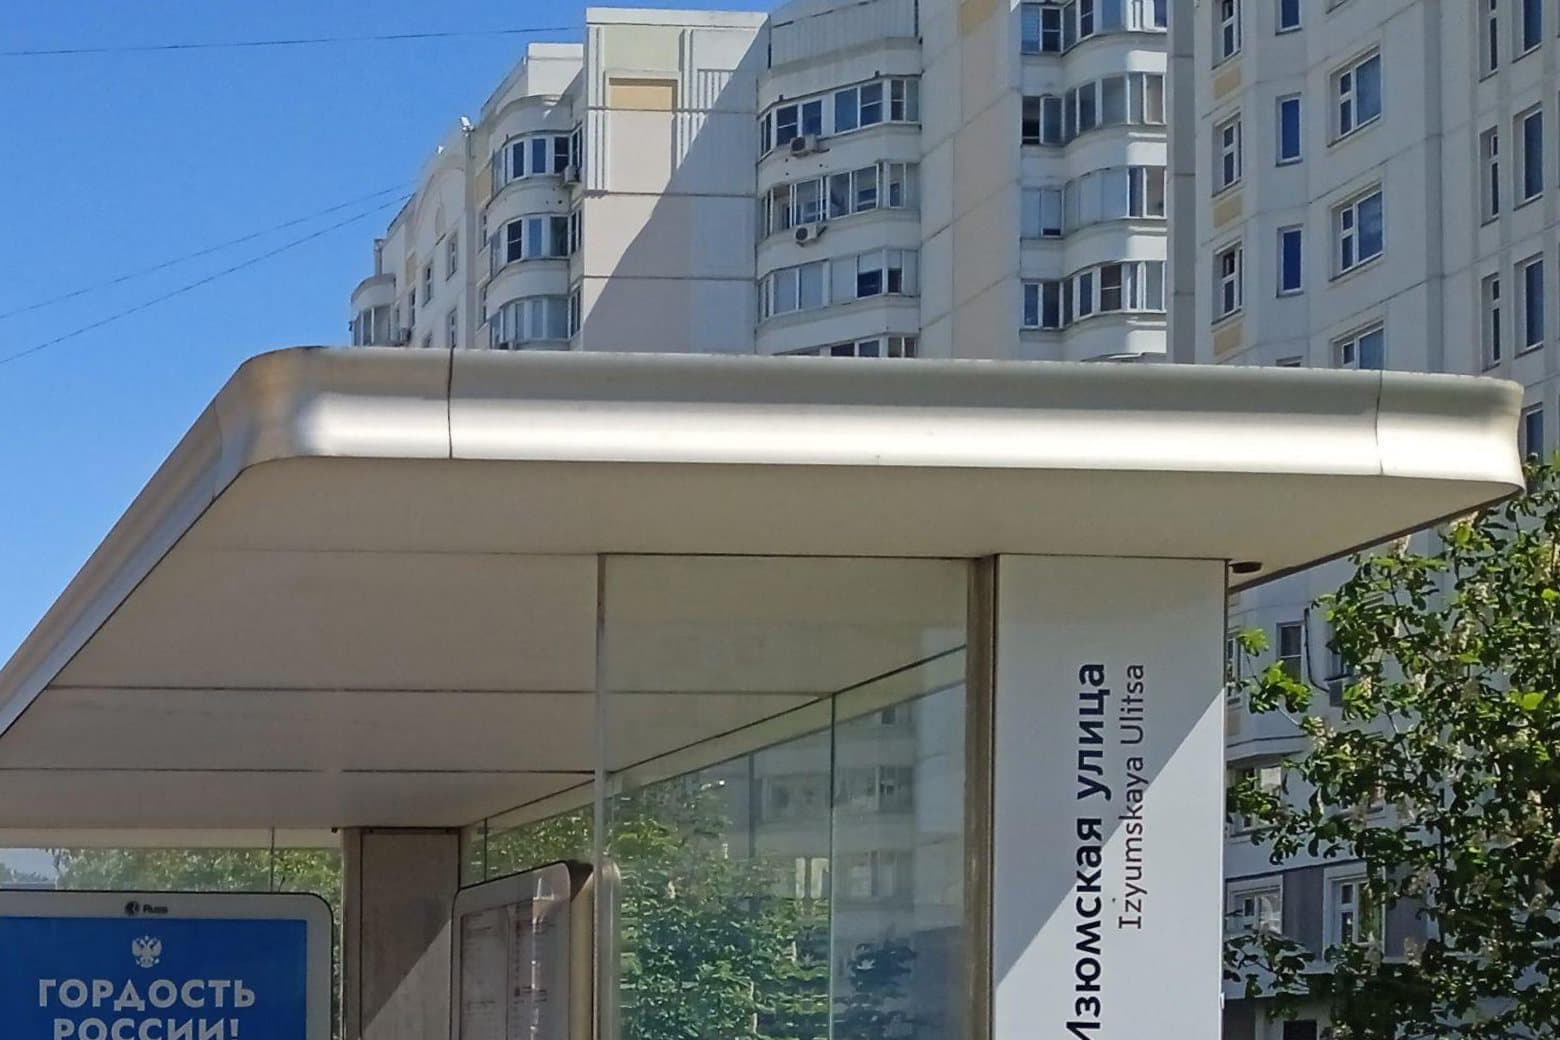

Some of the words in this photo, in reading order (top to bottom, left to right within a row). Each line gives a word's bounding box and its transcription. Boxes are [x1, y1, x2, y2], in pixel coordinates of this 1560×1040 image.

[1077, 664, 1111, 802] улица
[1119, 665, 1144, 744] Ulitsa
[1118, 757, 1149, 929] Izyumskaya
[39, 979, 256, 1012] ГОРДОСТЬ
